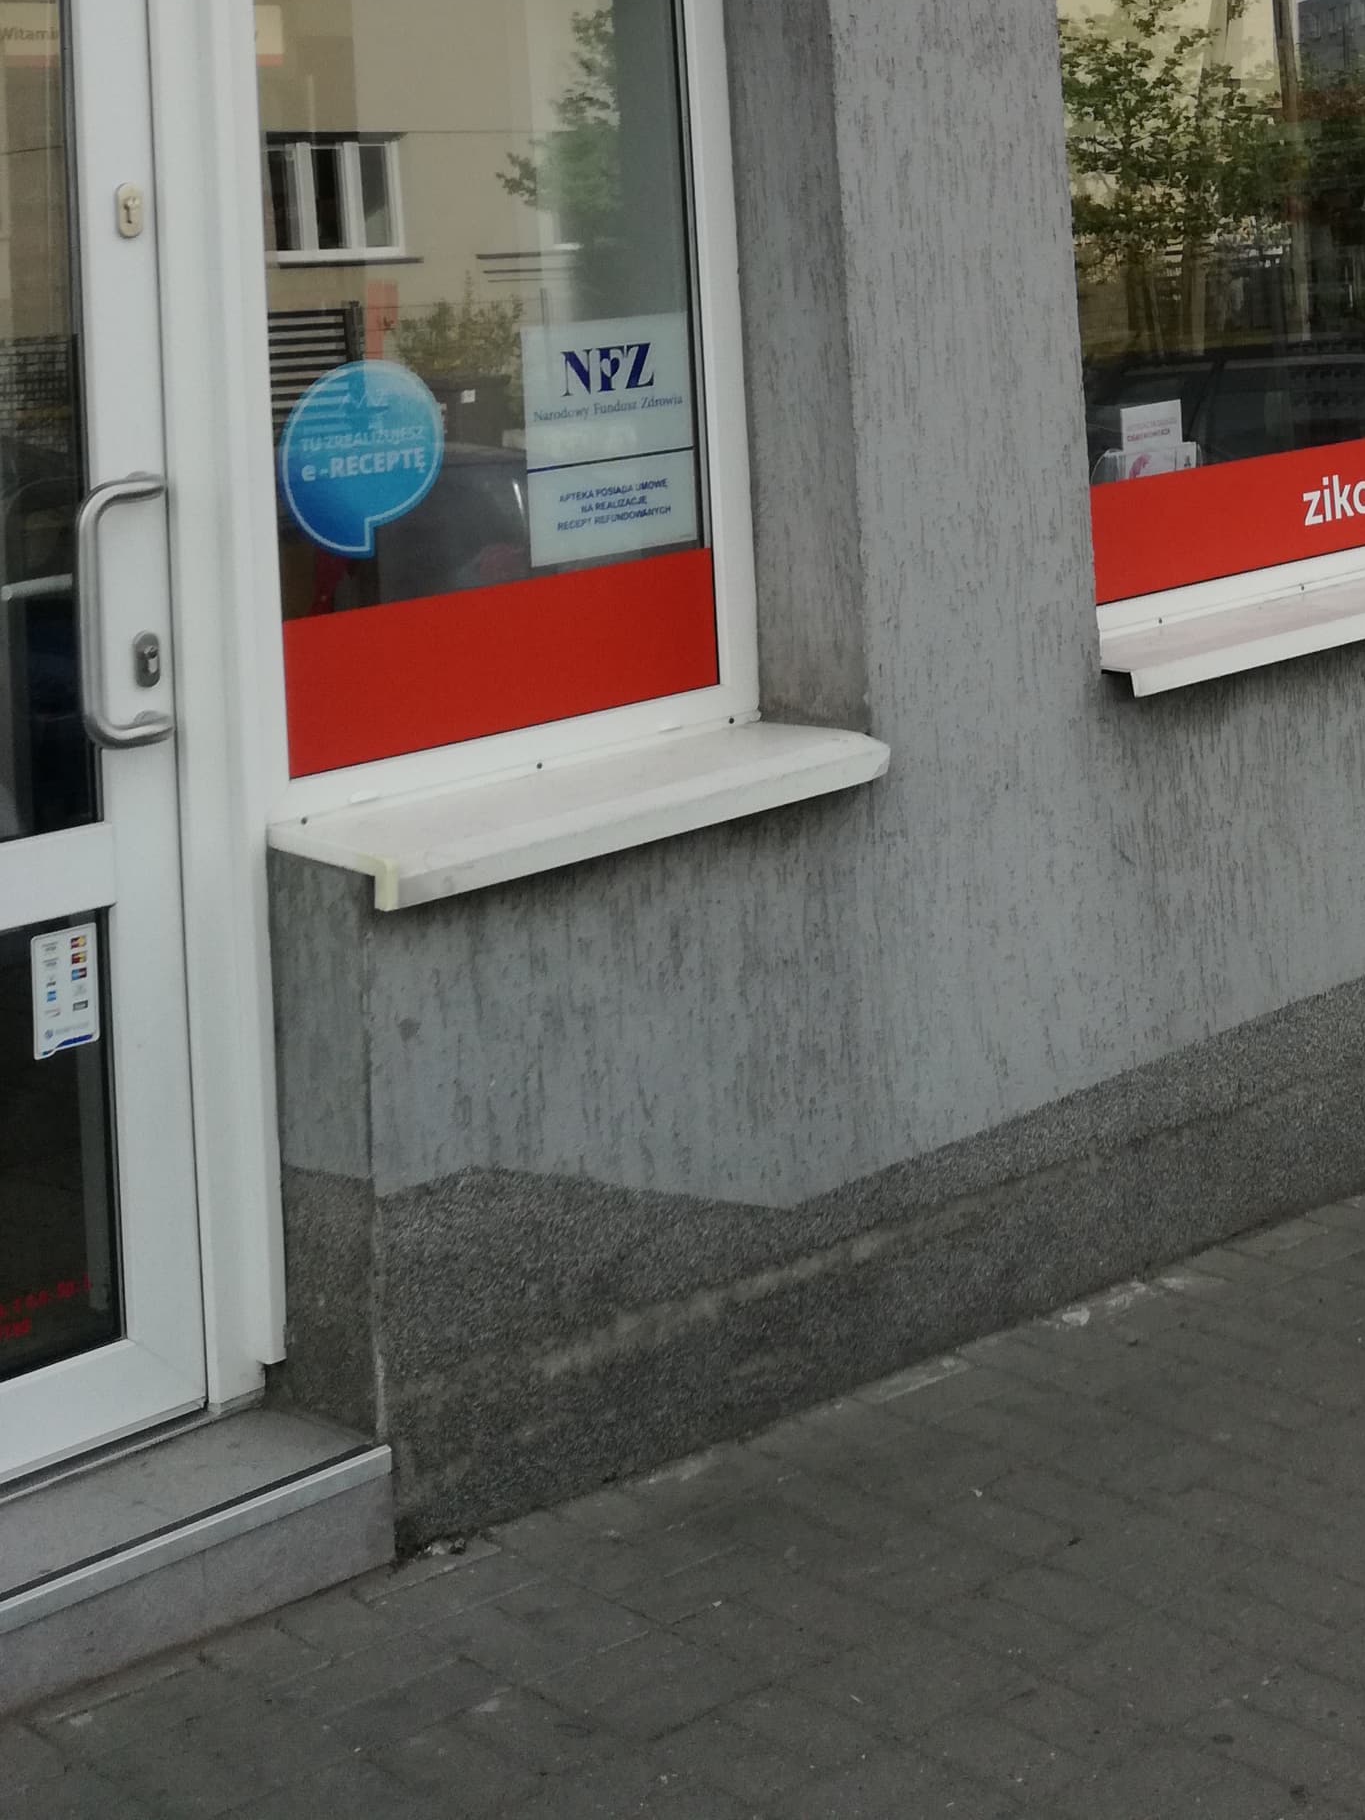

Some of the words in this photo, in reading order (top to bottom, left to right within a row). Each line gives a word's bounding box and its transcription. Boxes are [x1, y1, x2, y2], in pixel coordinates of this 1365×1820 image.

[0, 25, 58, 42] Witami
[560, 341, 656, 398] NFZ
[533, 405, 590, 423] Narodowy
[593, 400, 638, 416] Fundusz
[640, 394, 684, 411] Zdrowia
[301, 437, 322, 452] TU
[559, 487, 594, 503] APTEKA
[595, 483, 634, 499] POSIADA
[557, 517, 593, 531] RECEPT
[593, 505, 672, 526] REFUNDOWANYCH
[581, 503, 594, 514] NA
